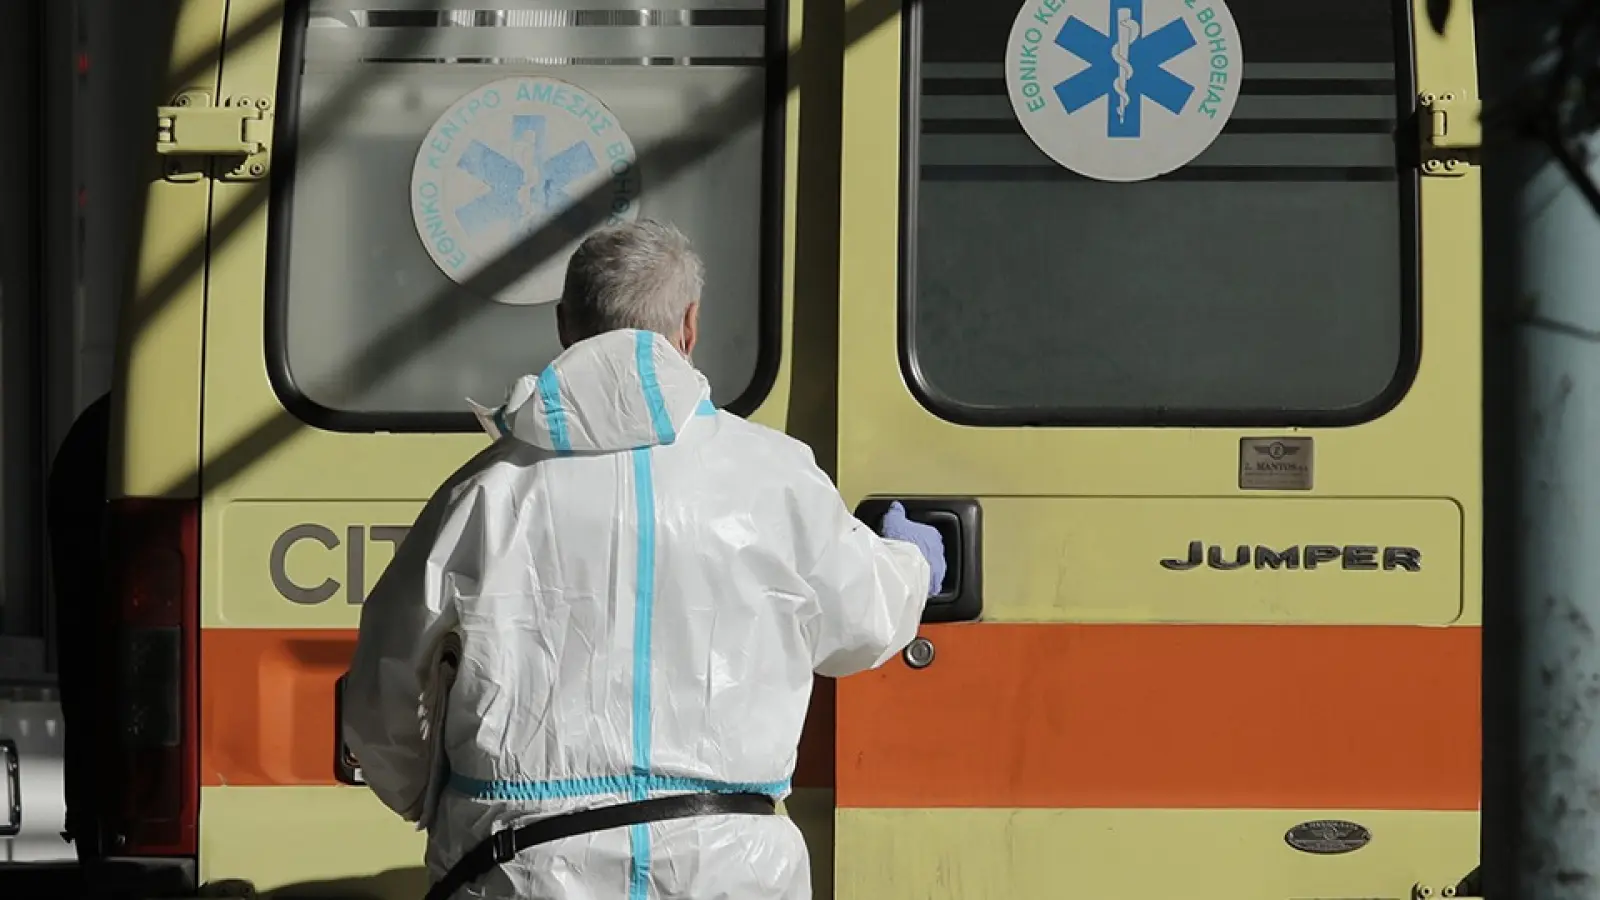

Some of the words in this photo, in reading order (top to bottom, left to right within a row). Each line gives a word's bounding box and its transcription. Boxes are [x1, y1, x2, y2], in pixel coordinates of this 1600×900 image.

[1020, 28, 1046, 112] ΕΘΝΙΚΟ
[1196, 7, 1229, 119] ΒΟΗΘΕΙΑΣ
[427, 89, 501, 169] ΚΕΝΤΡΟ
[516, 82, 613, 136] ΑΜΕΣΗΣ
[419, 182, 467, 270] ΕΘΝΙΚΟ
[1160, 540, 1421, 571] JUMPER
